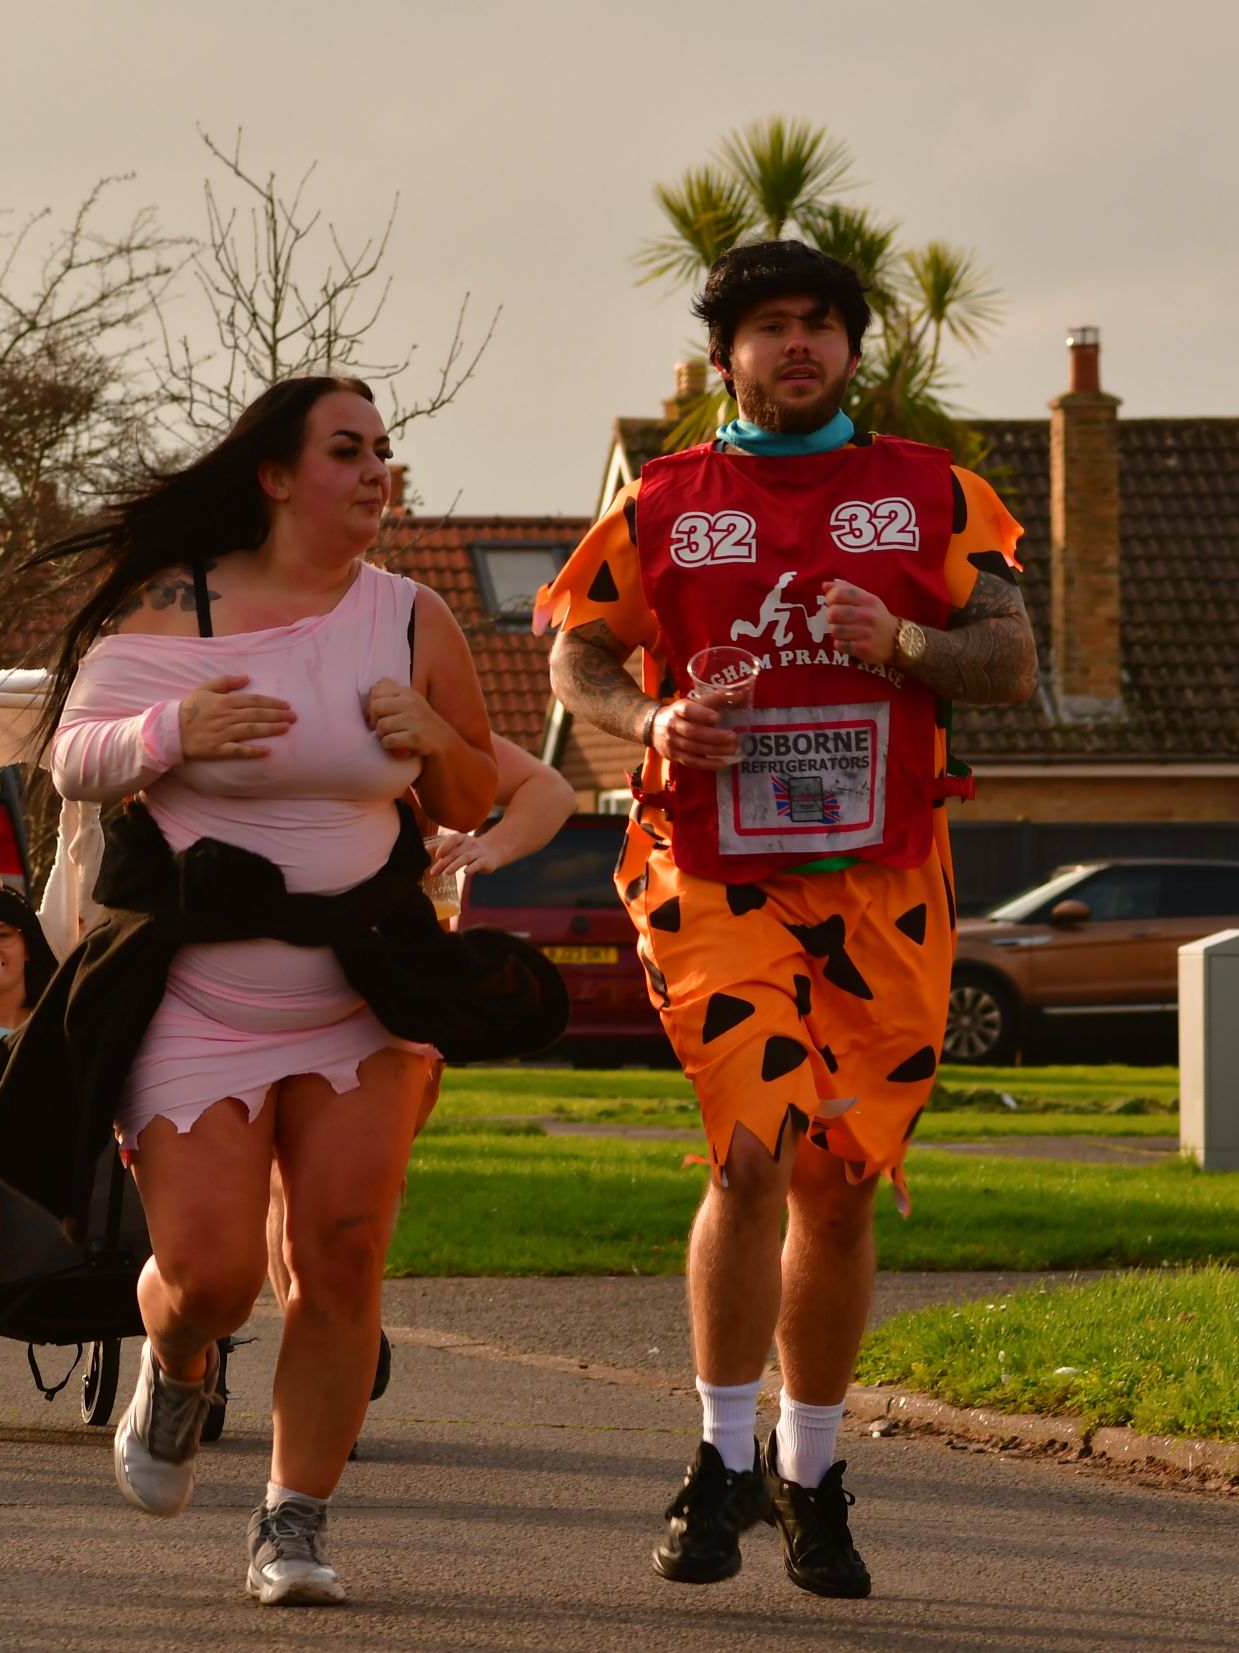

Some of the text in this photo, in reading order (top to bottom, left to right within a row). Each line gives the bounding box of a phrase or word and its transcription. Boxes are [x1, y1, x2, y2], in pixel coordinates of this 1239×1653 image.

[670, 510, 757, 568] 32
[830, 497, 920, 553] 32
[779, 648, 851, 668] PRAM
[856, 661, 905, 690] RACE
[740, 729, 869, 757] OSBORNE
[741, 755, 870, 774] REFRIGERATORS
